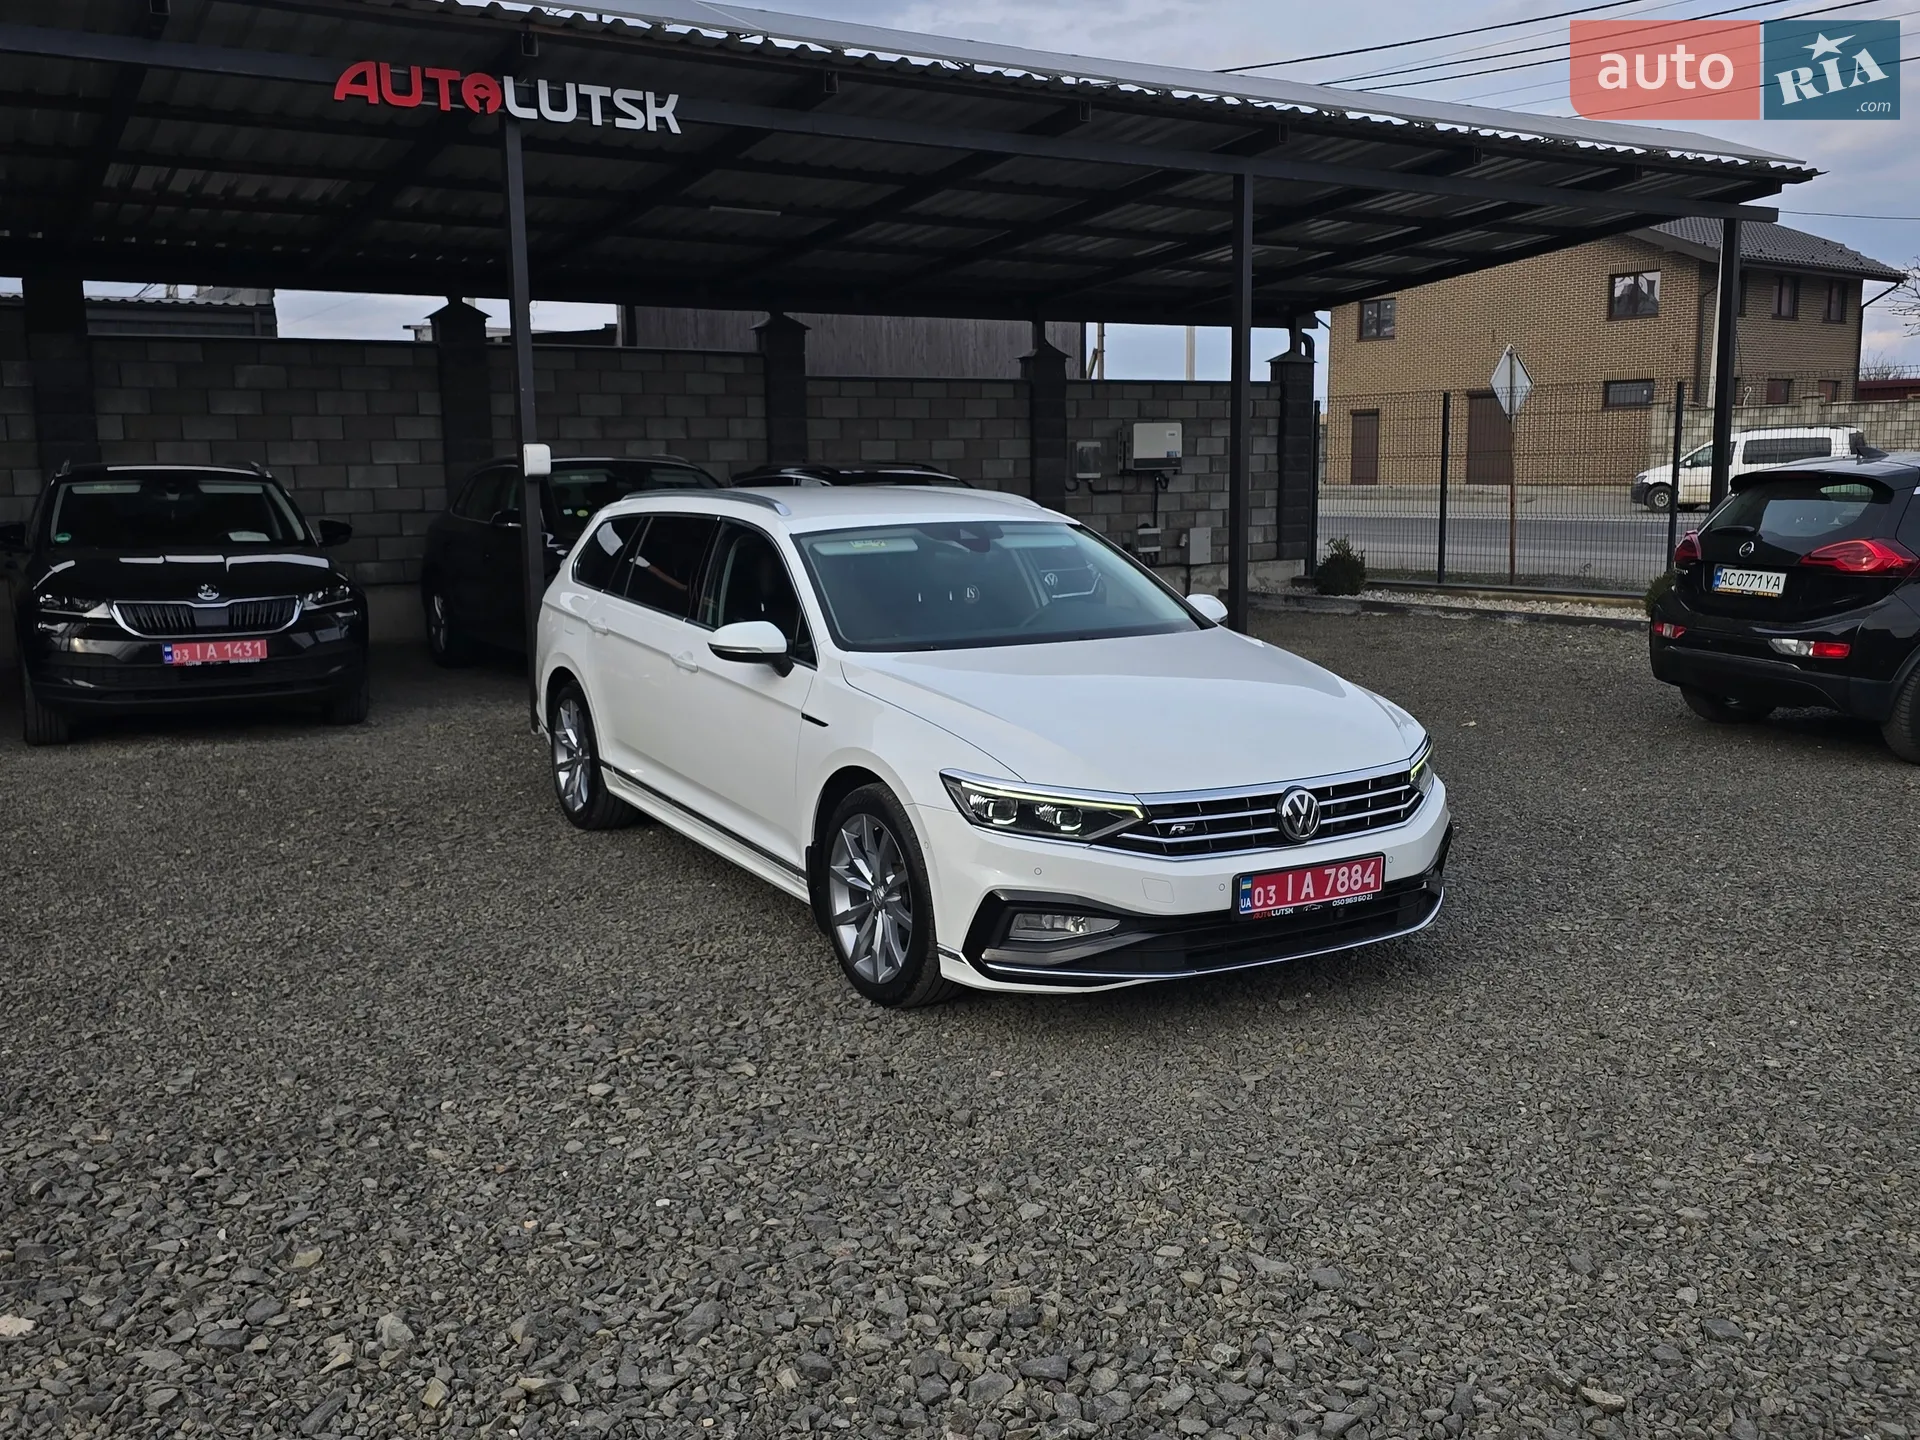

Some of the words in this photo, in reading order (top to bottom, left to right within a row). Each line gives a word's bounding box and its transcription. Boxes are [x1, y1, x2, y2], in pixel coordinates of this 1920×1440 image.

[174, 649, 189, 660] 03
[224, 641, 261, 658] 1431
[1254, 885, 1276, 907] 03
[1324, 861, 1376, 896] 7884
[1240, 898, 1252, 909] UA
